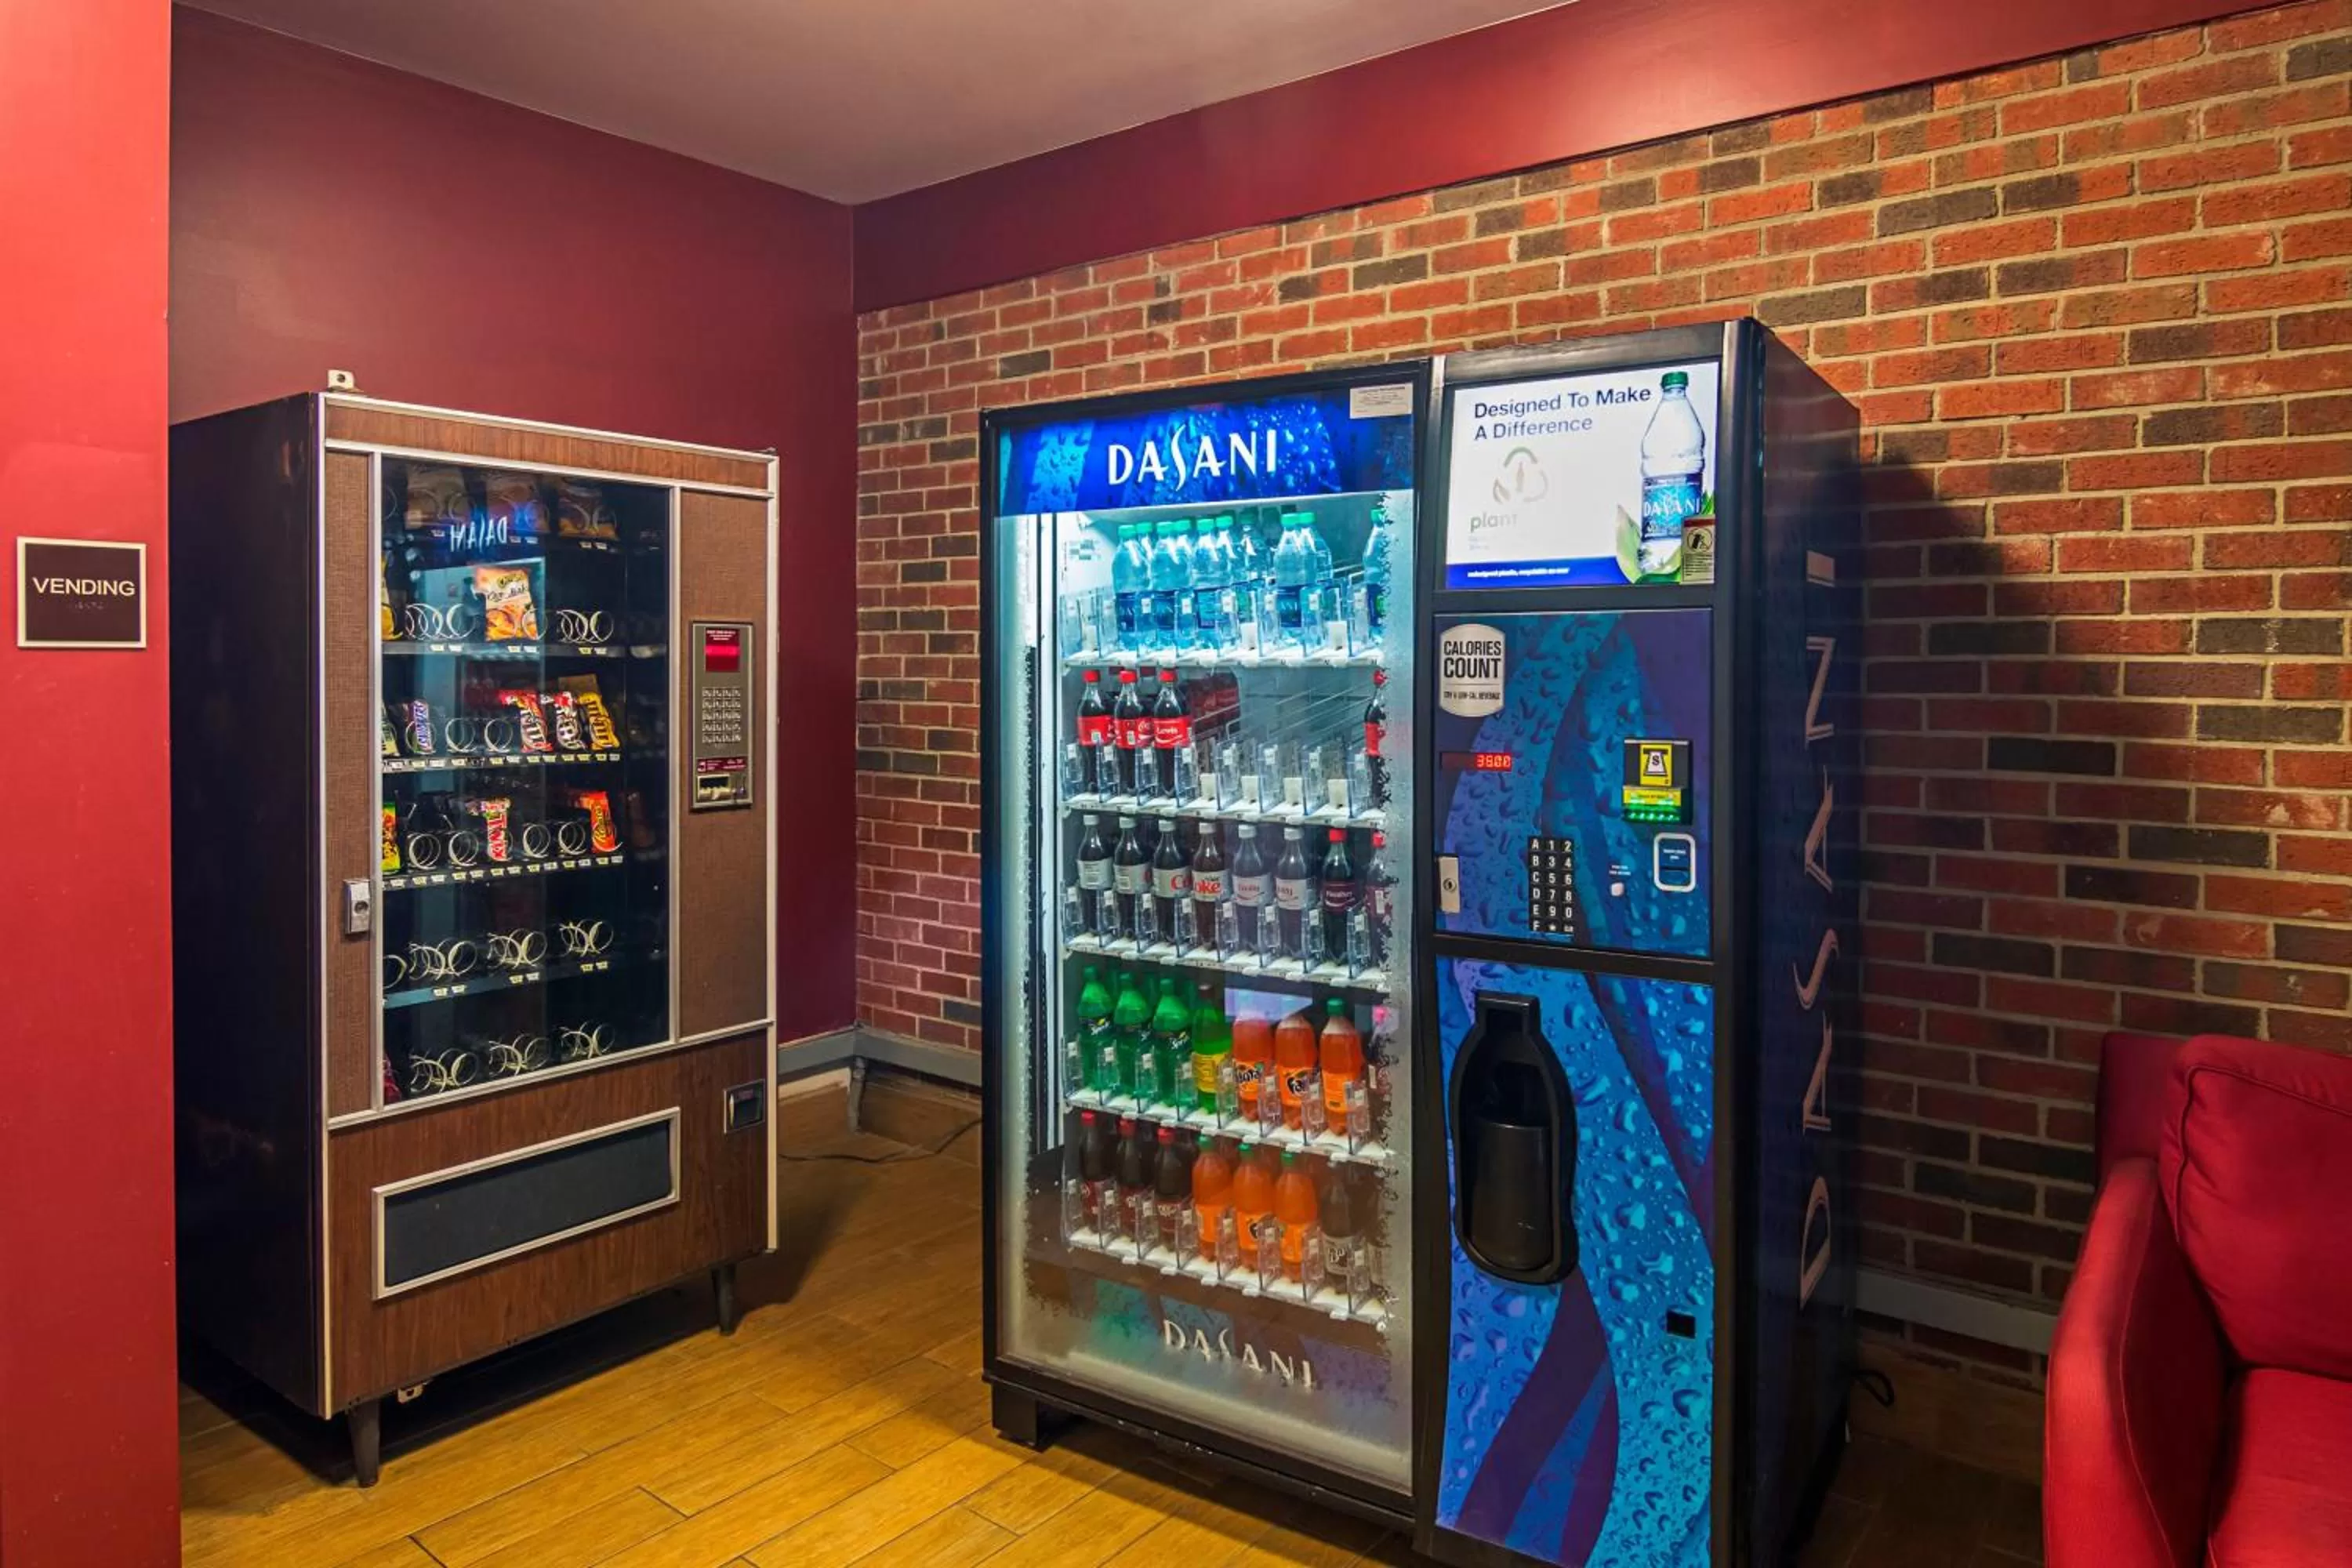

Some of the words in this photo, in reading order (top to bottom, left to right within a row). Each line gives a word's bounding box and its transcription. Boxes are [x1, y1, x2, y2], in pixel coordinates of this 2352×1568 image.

[1474, 394, 1561, 418] Designed
[1568, 392, 1589, 408] To
[1595, 386, 1651, 405] Make
[1474, 426, 1487, 441] A
[1493, 416, 1592, 440] Difference
[1108, 424, 1276, 492] DASANI
[32, 576, 136, 597] VENDING
[1444, 641, 1501, 656] CALORIES
[1444, 657, 1501, 678] COUNT
[1531, 838, 1539, 850] A
[1549, 840, 1555, 851] 1
[1564, 840, 1572, 852] 2
[1533, 855, 1539, 866] B
[1548, 855, 1555, 867] 3
[1565, 858, 1572, 868] 4
[1533, 871, 1540, 883] C
[1548, 873, 1556, 884] 5
[1533, 887, 1541, 899] D
[1549, 889, 1556, 900] 7
[1533, 904, 1540, 916] E
[1548, 906, 1556, 916] 9
[1533, 920, 1540, 931] F
[1793, 550, 1840, 1309] DASANI
[1163, 1319, 1313, 1388] DASANI
